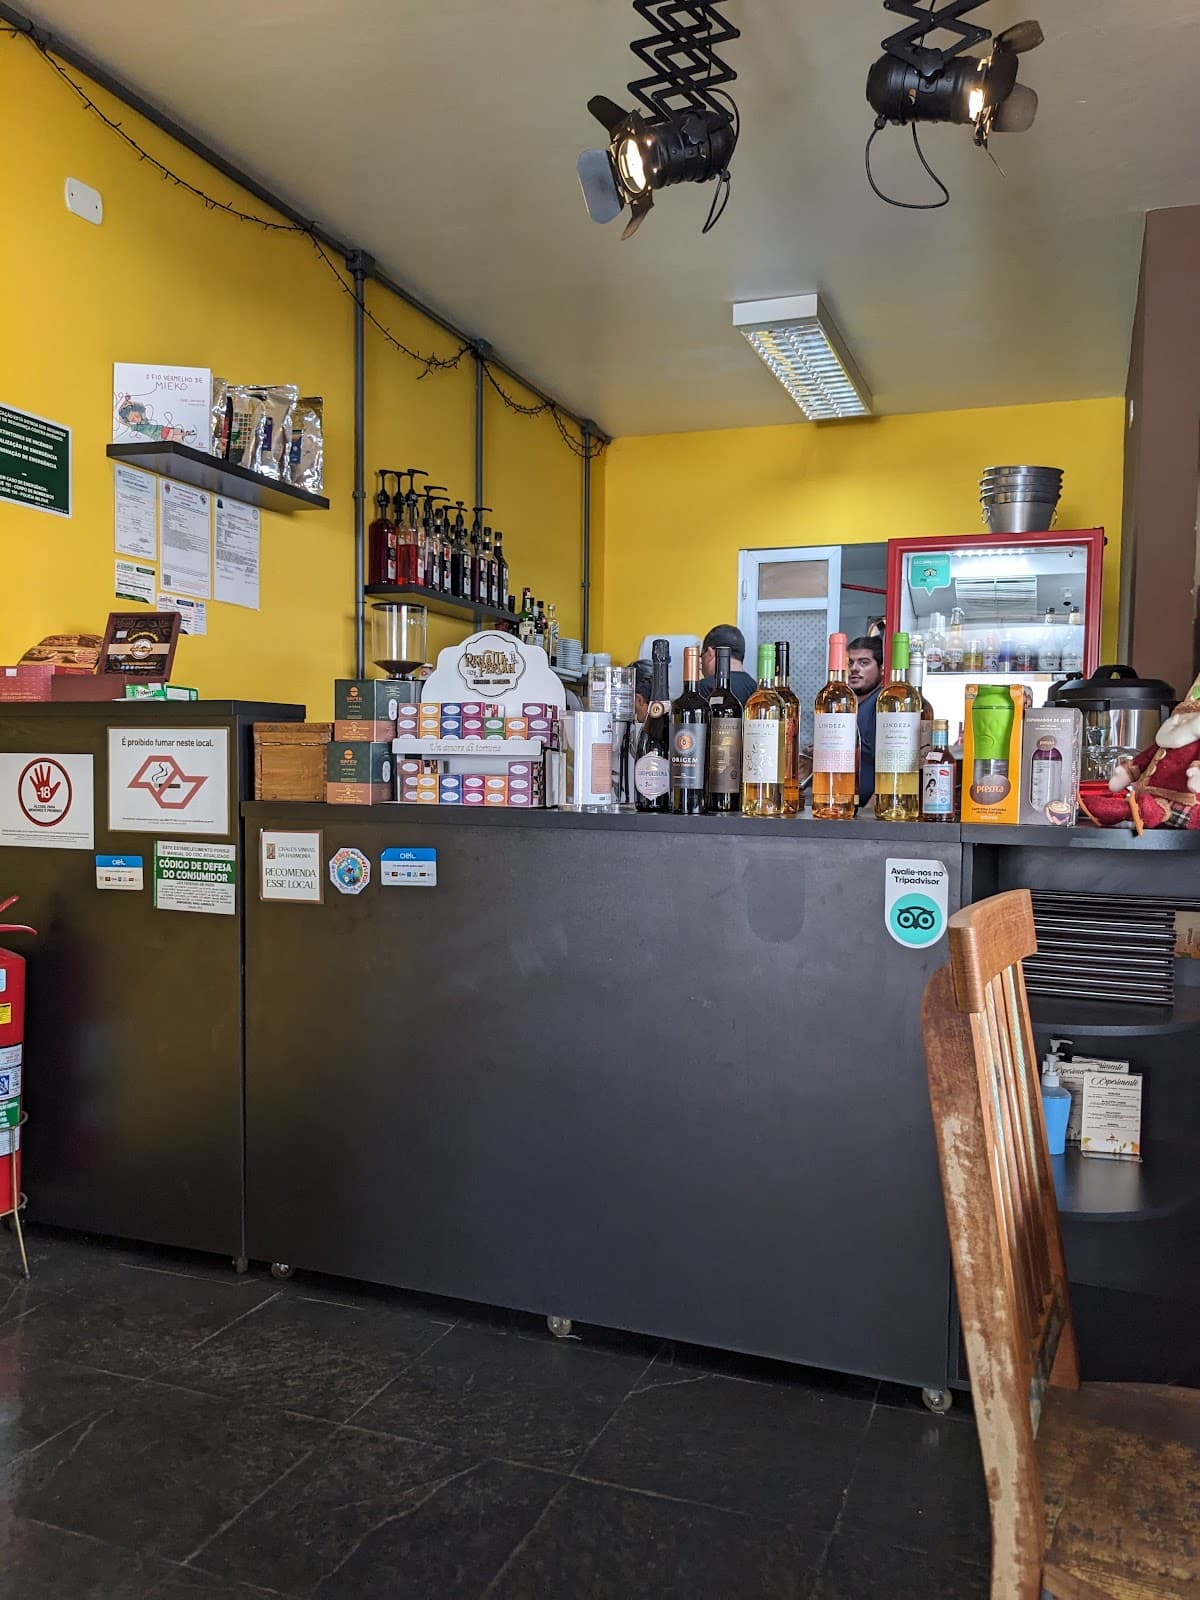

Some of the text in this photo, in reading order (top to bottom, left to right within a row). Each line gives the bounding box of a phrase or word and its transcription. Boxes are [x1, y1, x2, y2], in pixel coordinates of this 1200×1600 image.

[163, 375, 192, 383] VERMELHO
[155, 382, 188, 391] MIEKO
[121, 736, 214, 747] É proibido fumar neste local.
[37, 786, 51, 799] -18
[159, 858, 232, 872] CÓDIGO DE DEFESA
[163, 869, 228, 882] DO CONSUMIDOR
[265, 867, 317, 878] RECOMENDA
[890, 867, 932, 877] Avalie-nos
[267, 879, 317, 890] ESSE LOCAL
[893, 876, 941, 885] Tripadvisor
